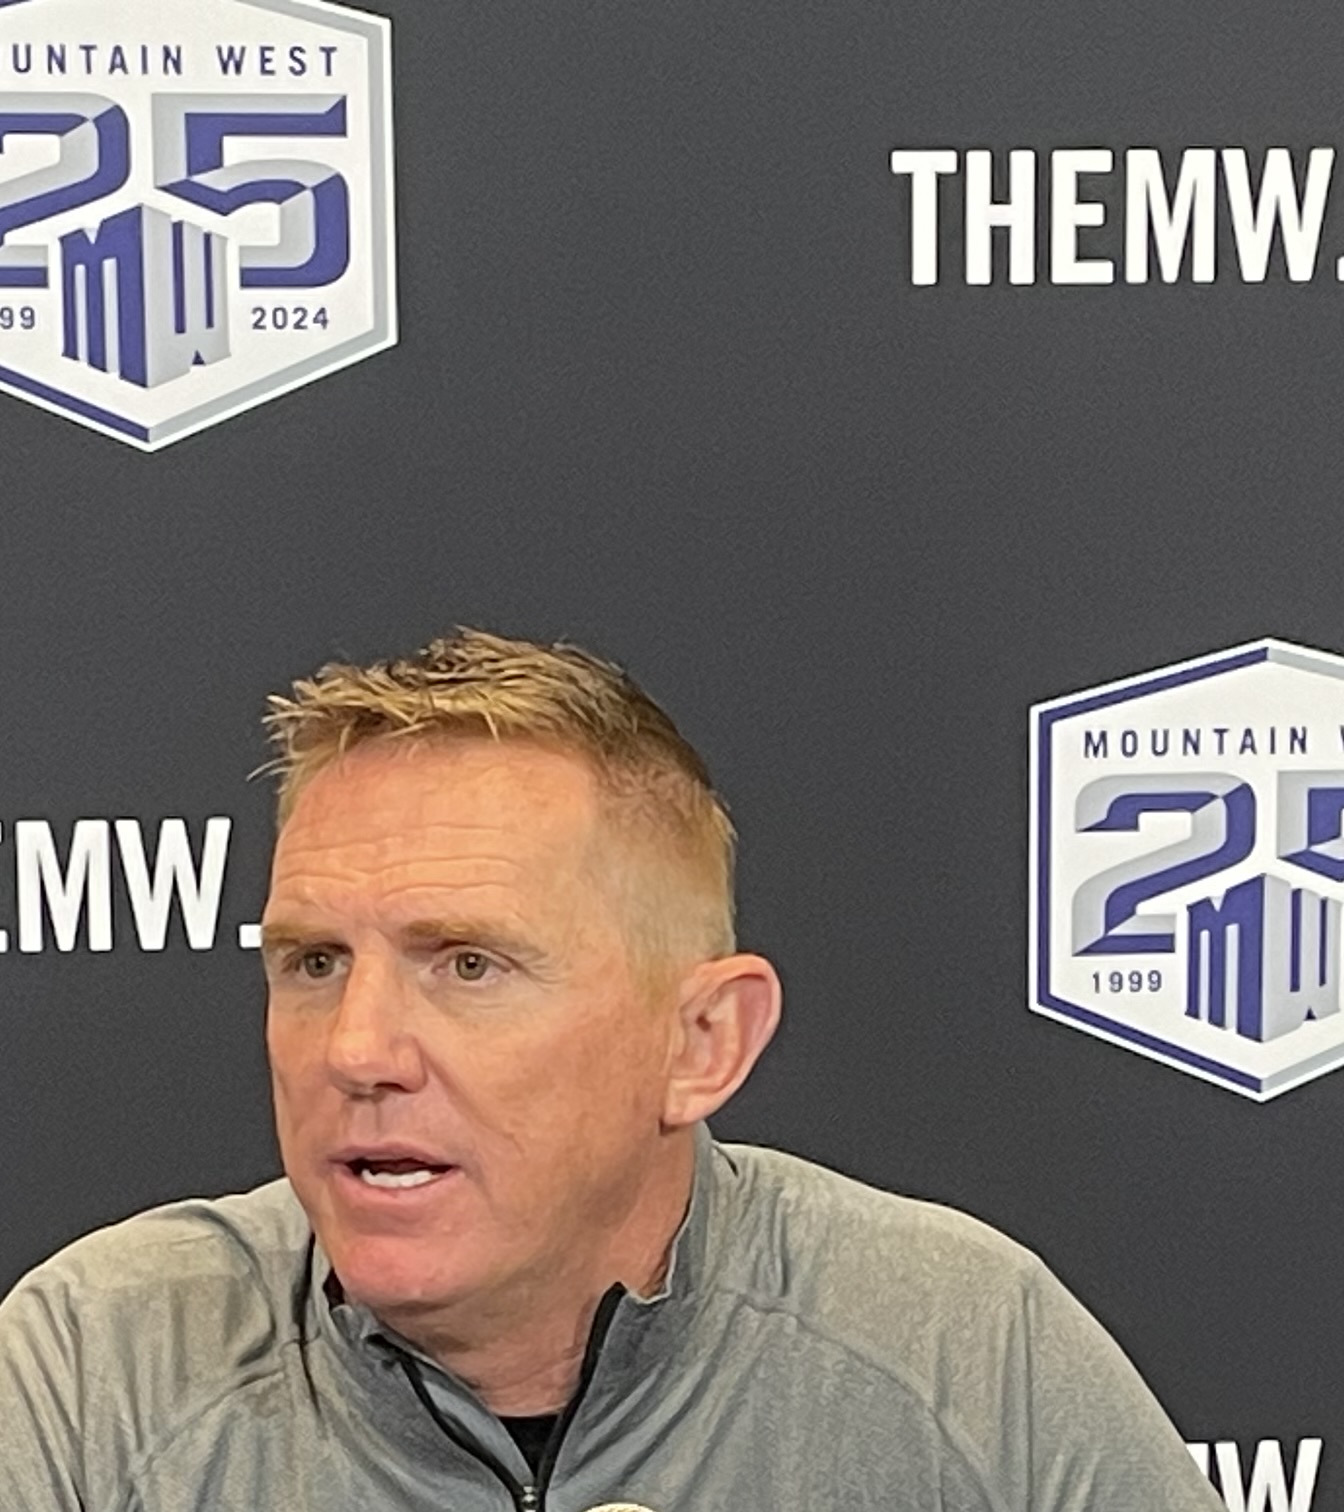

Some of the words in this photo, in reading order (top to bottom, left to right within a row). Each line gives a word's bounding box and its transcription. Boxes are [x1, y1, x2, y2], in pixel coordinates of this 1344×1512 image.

[216, 45, 338, 76] WEST
[250, 305, 329, 331] 2024
[1084, 725, 1308, 759] MOUNTAIN
[1092, 969, 1163, 993] 1999
